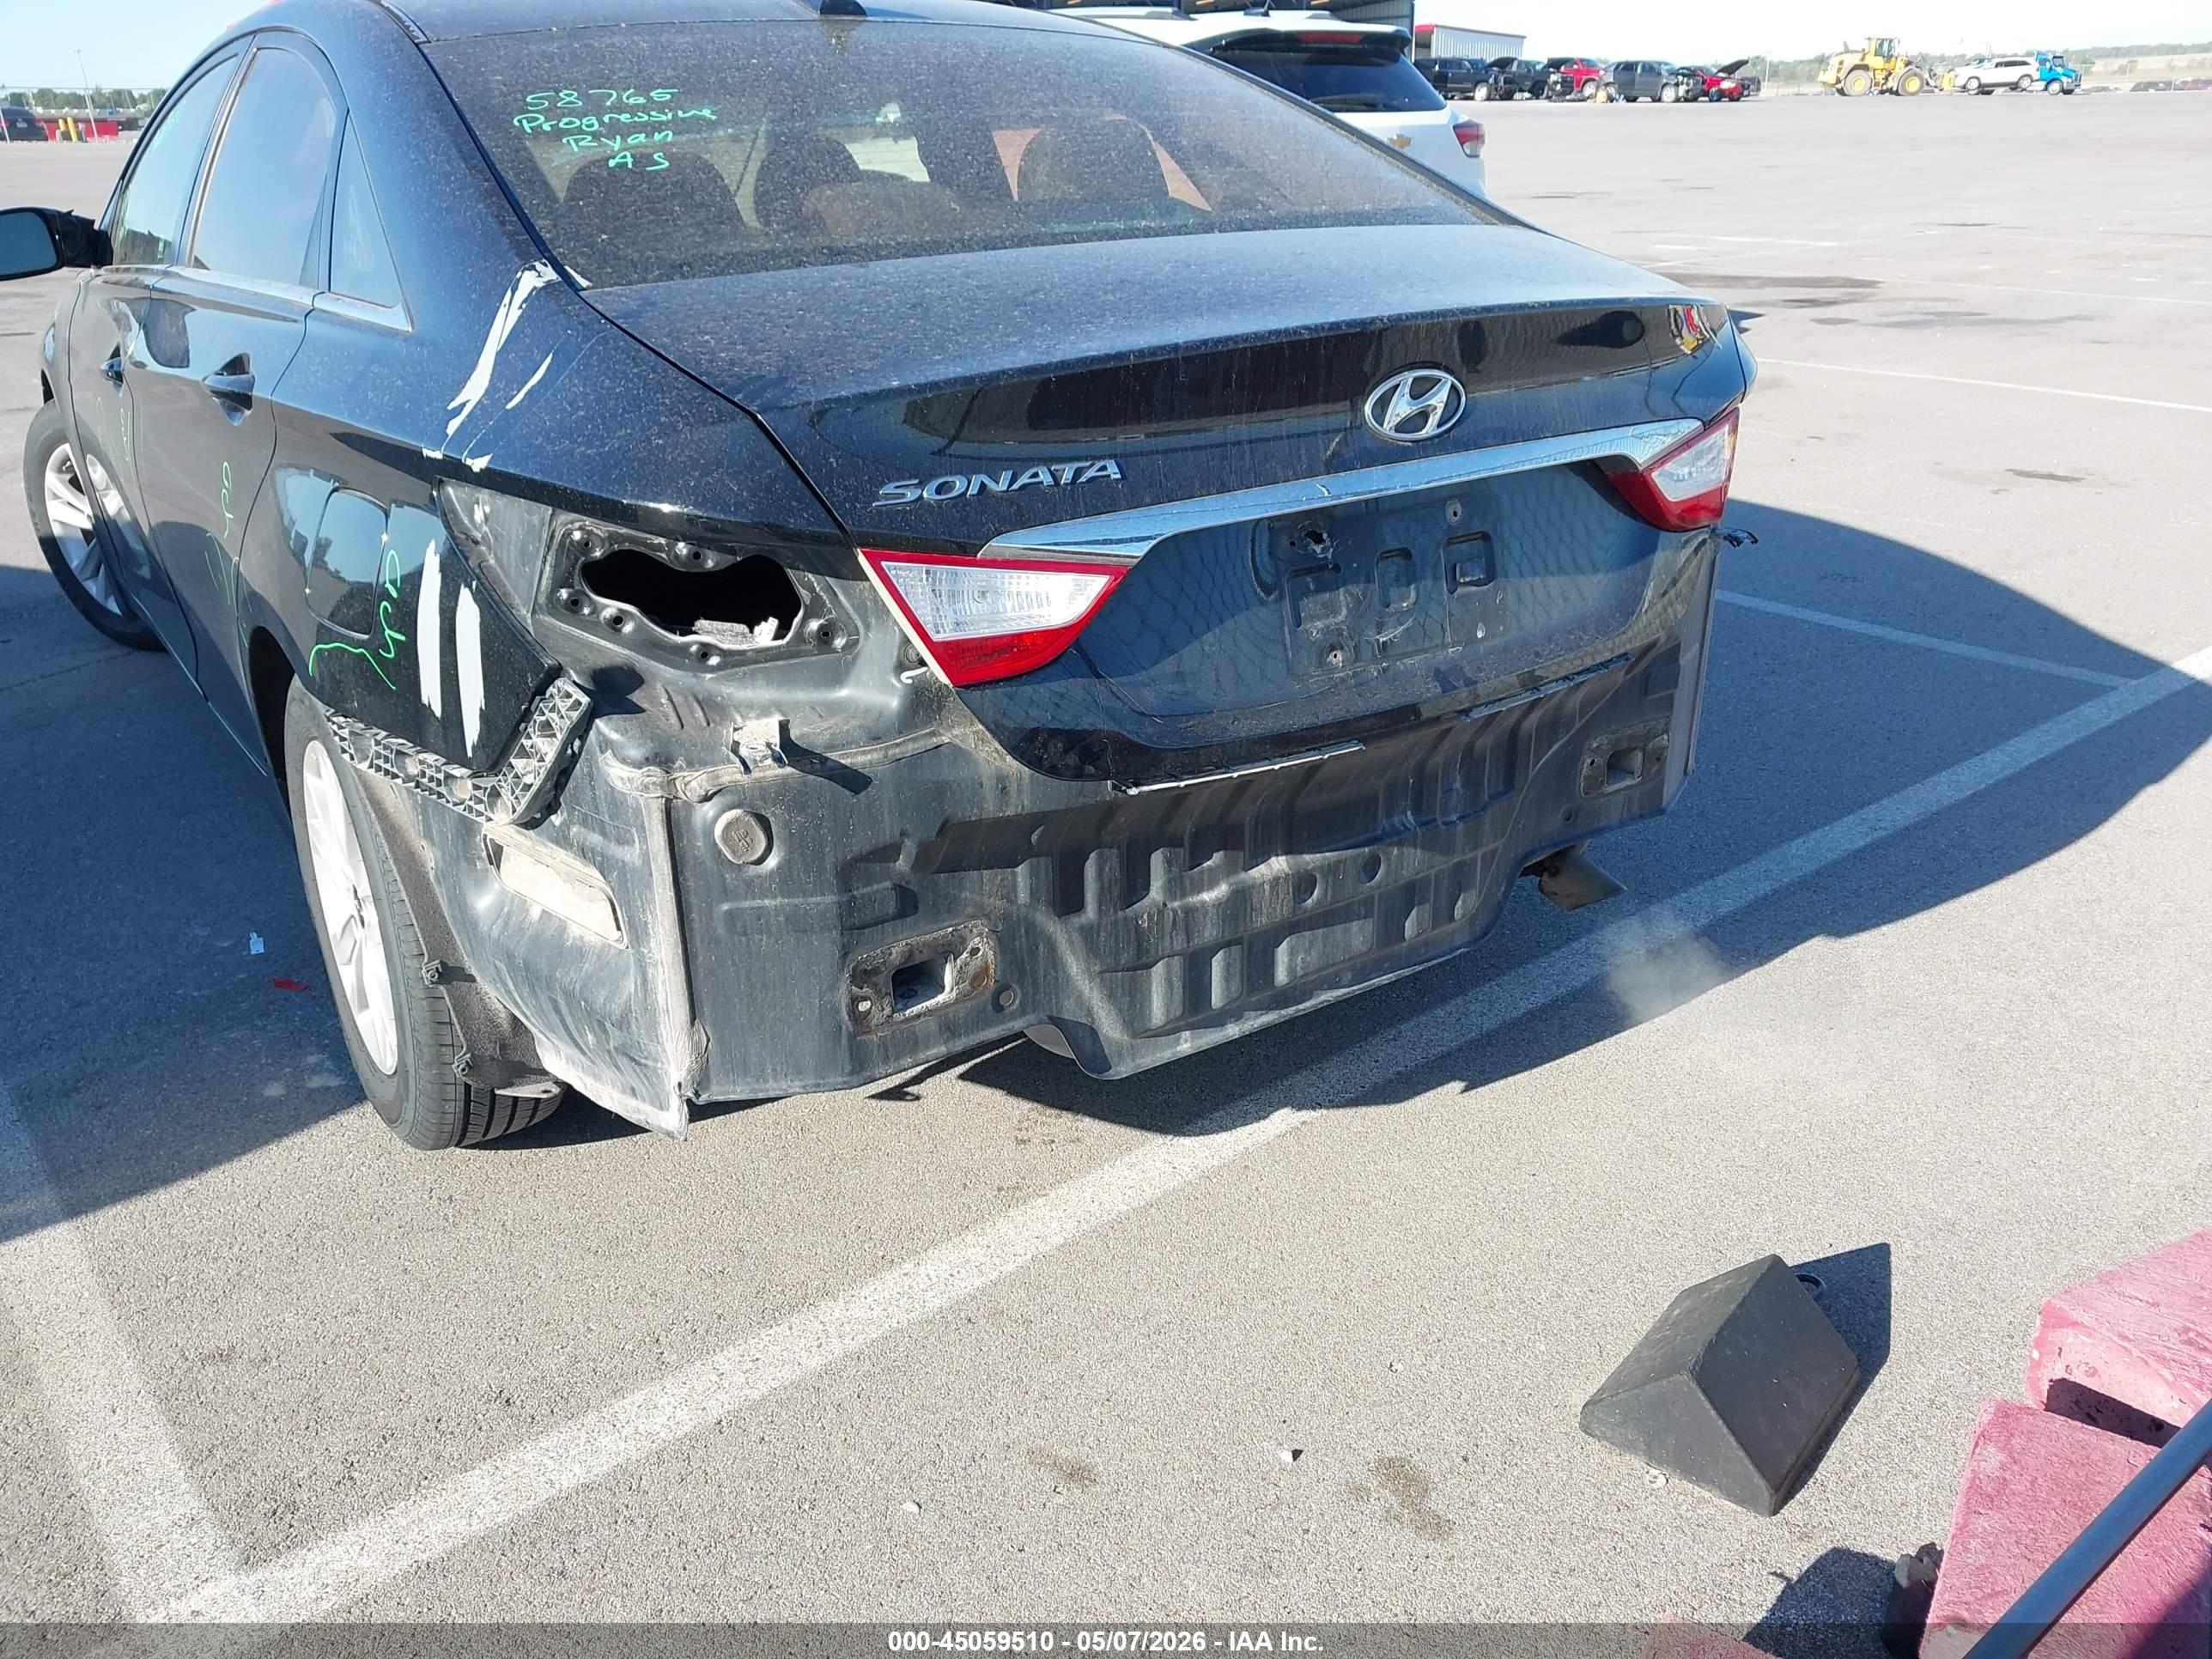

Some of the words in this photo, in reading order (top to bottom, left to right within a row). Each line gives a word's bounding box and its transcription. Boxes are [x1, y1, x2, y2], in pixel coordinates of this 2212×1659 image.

[526, 88, 680, 110] 58765
[562, 130, 673, 152] Ryan
[872, 459, 1122, 507] SONATA
